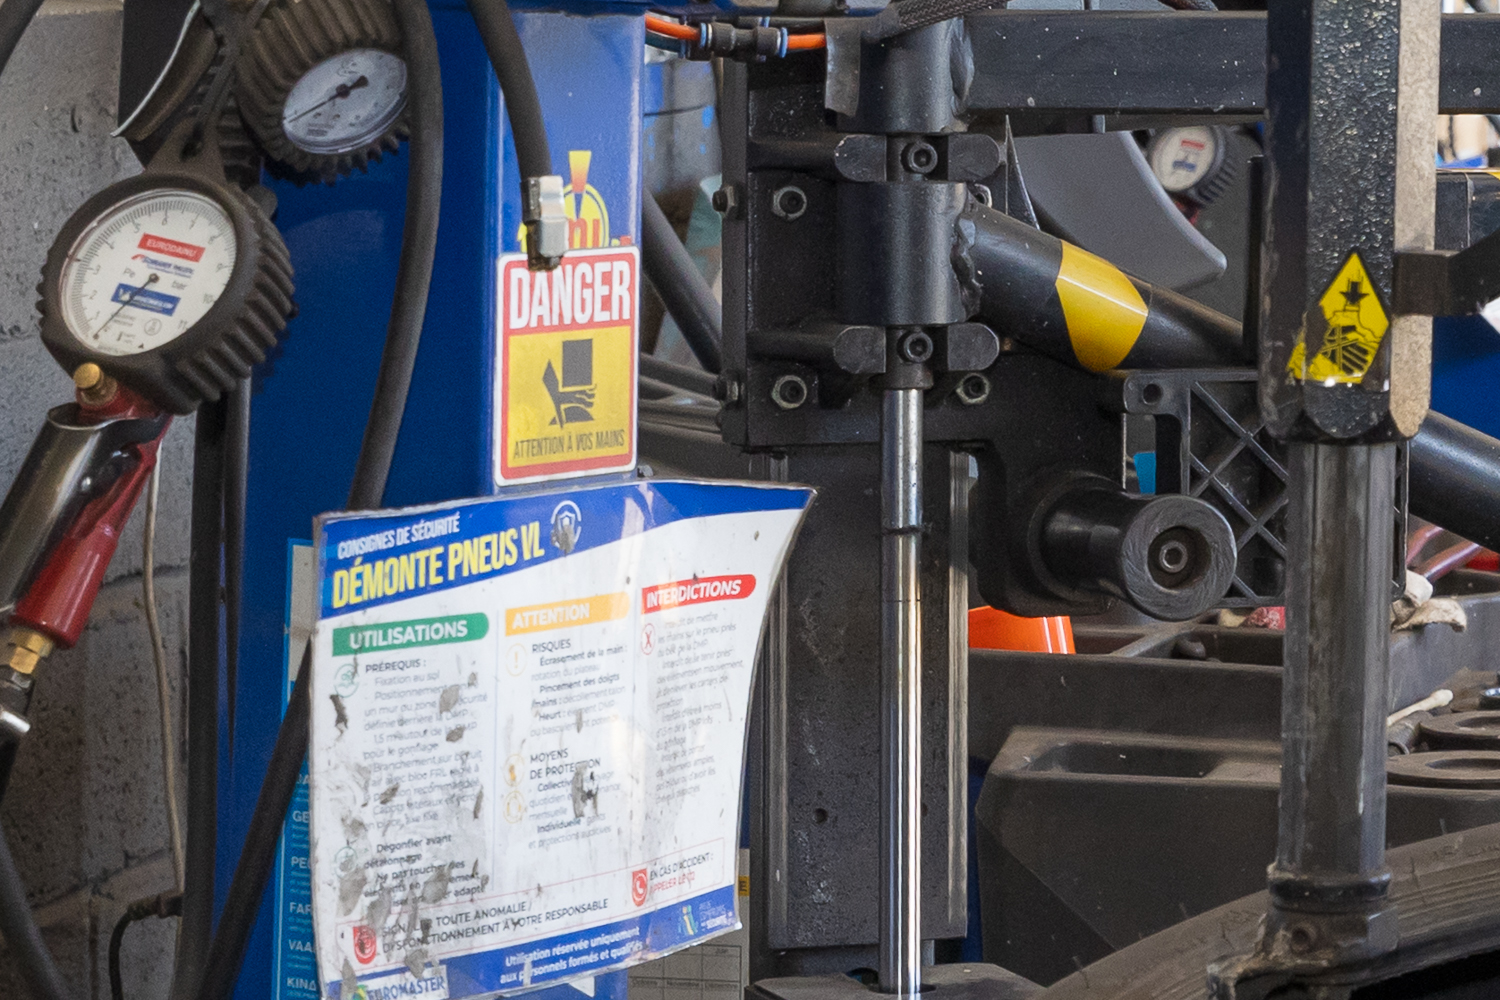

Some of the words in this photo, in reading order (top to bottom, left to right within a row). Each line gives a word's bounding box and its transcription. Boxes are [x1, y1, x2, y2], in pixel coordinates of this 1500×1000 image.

[509, 260, 631, 329] DANGER
[513, 435, 564, 460] ATTENTION
[576, 431, 593, 451] VOS
[595, 428, 625, 448] MAINS
[337, 529, 395, 560] CONSIGNES
[396, 526, 411, 541] DE
[411, 511, 461, 542] SÉCURITÉ
[332, 545, 444, 609] DÉMONTE
[448, 527, 518, 581] PNEUS
[521, 520, 545, 561] VL
[646, 579, 742, 609] INTERDICTIONS
[512, 602, 590, 630] ATTENTION
[350, 619, 468, 650] UTILISATIONS
[532, 638, 571, 655] RISQUES
[365, 658, 421, 674] PRÉREQUIS
[530, 748, 568, 763] MOYENS
[530, 768, 542, 780] DE
[436, 911, 471, 927] TOUTE
[473, 901, 527, 921] ANOMALIE
[545, 898, 609, 922] RESPONSABLE
[505, 947, 551, 967] Utilisation
[552, 938, 589, 956] réservée
[591, 926, 640, 948] uniquement
[500, 973, 517, 984] aux
[518, 959, 567, 982] prsonnels
[569, 949, 599, 968] formés
